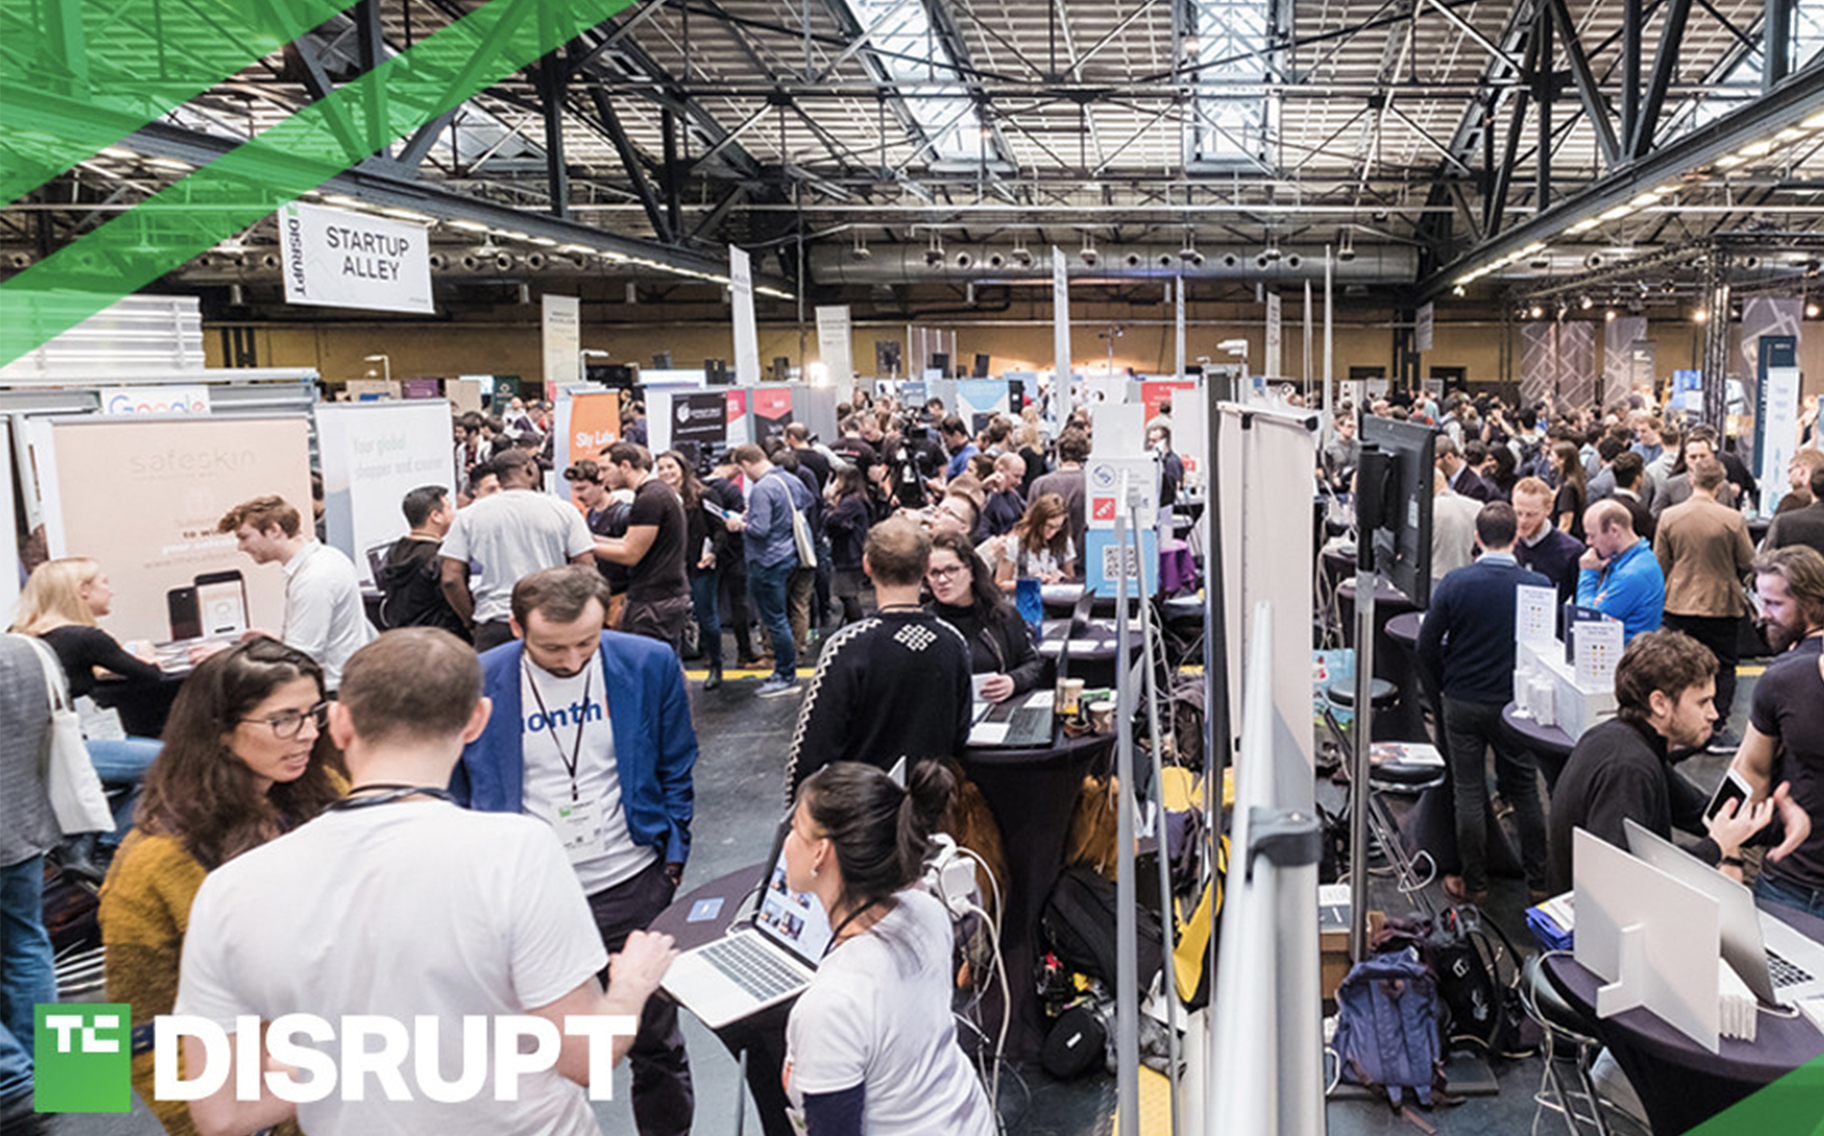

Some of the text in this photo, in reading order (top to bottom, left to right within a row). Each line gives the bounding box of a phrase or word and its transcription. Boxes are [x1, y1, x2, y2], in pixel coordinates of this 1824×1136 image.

[287, 218, 307, 296] DISRUPT
[326, 226, 410, 258] STARTUP
[342, 256, 400, 281] ALLEY
[520, 697, 602, 734] onth
